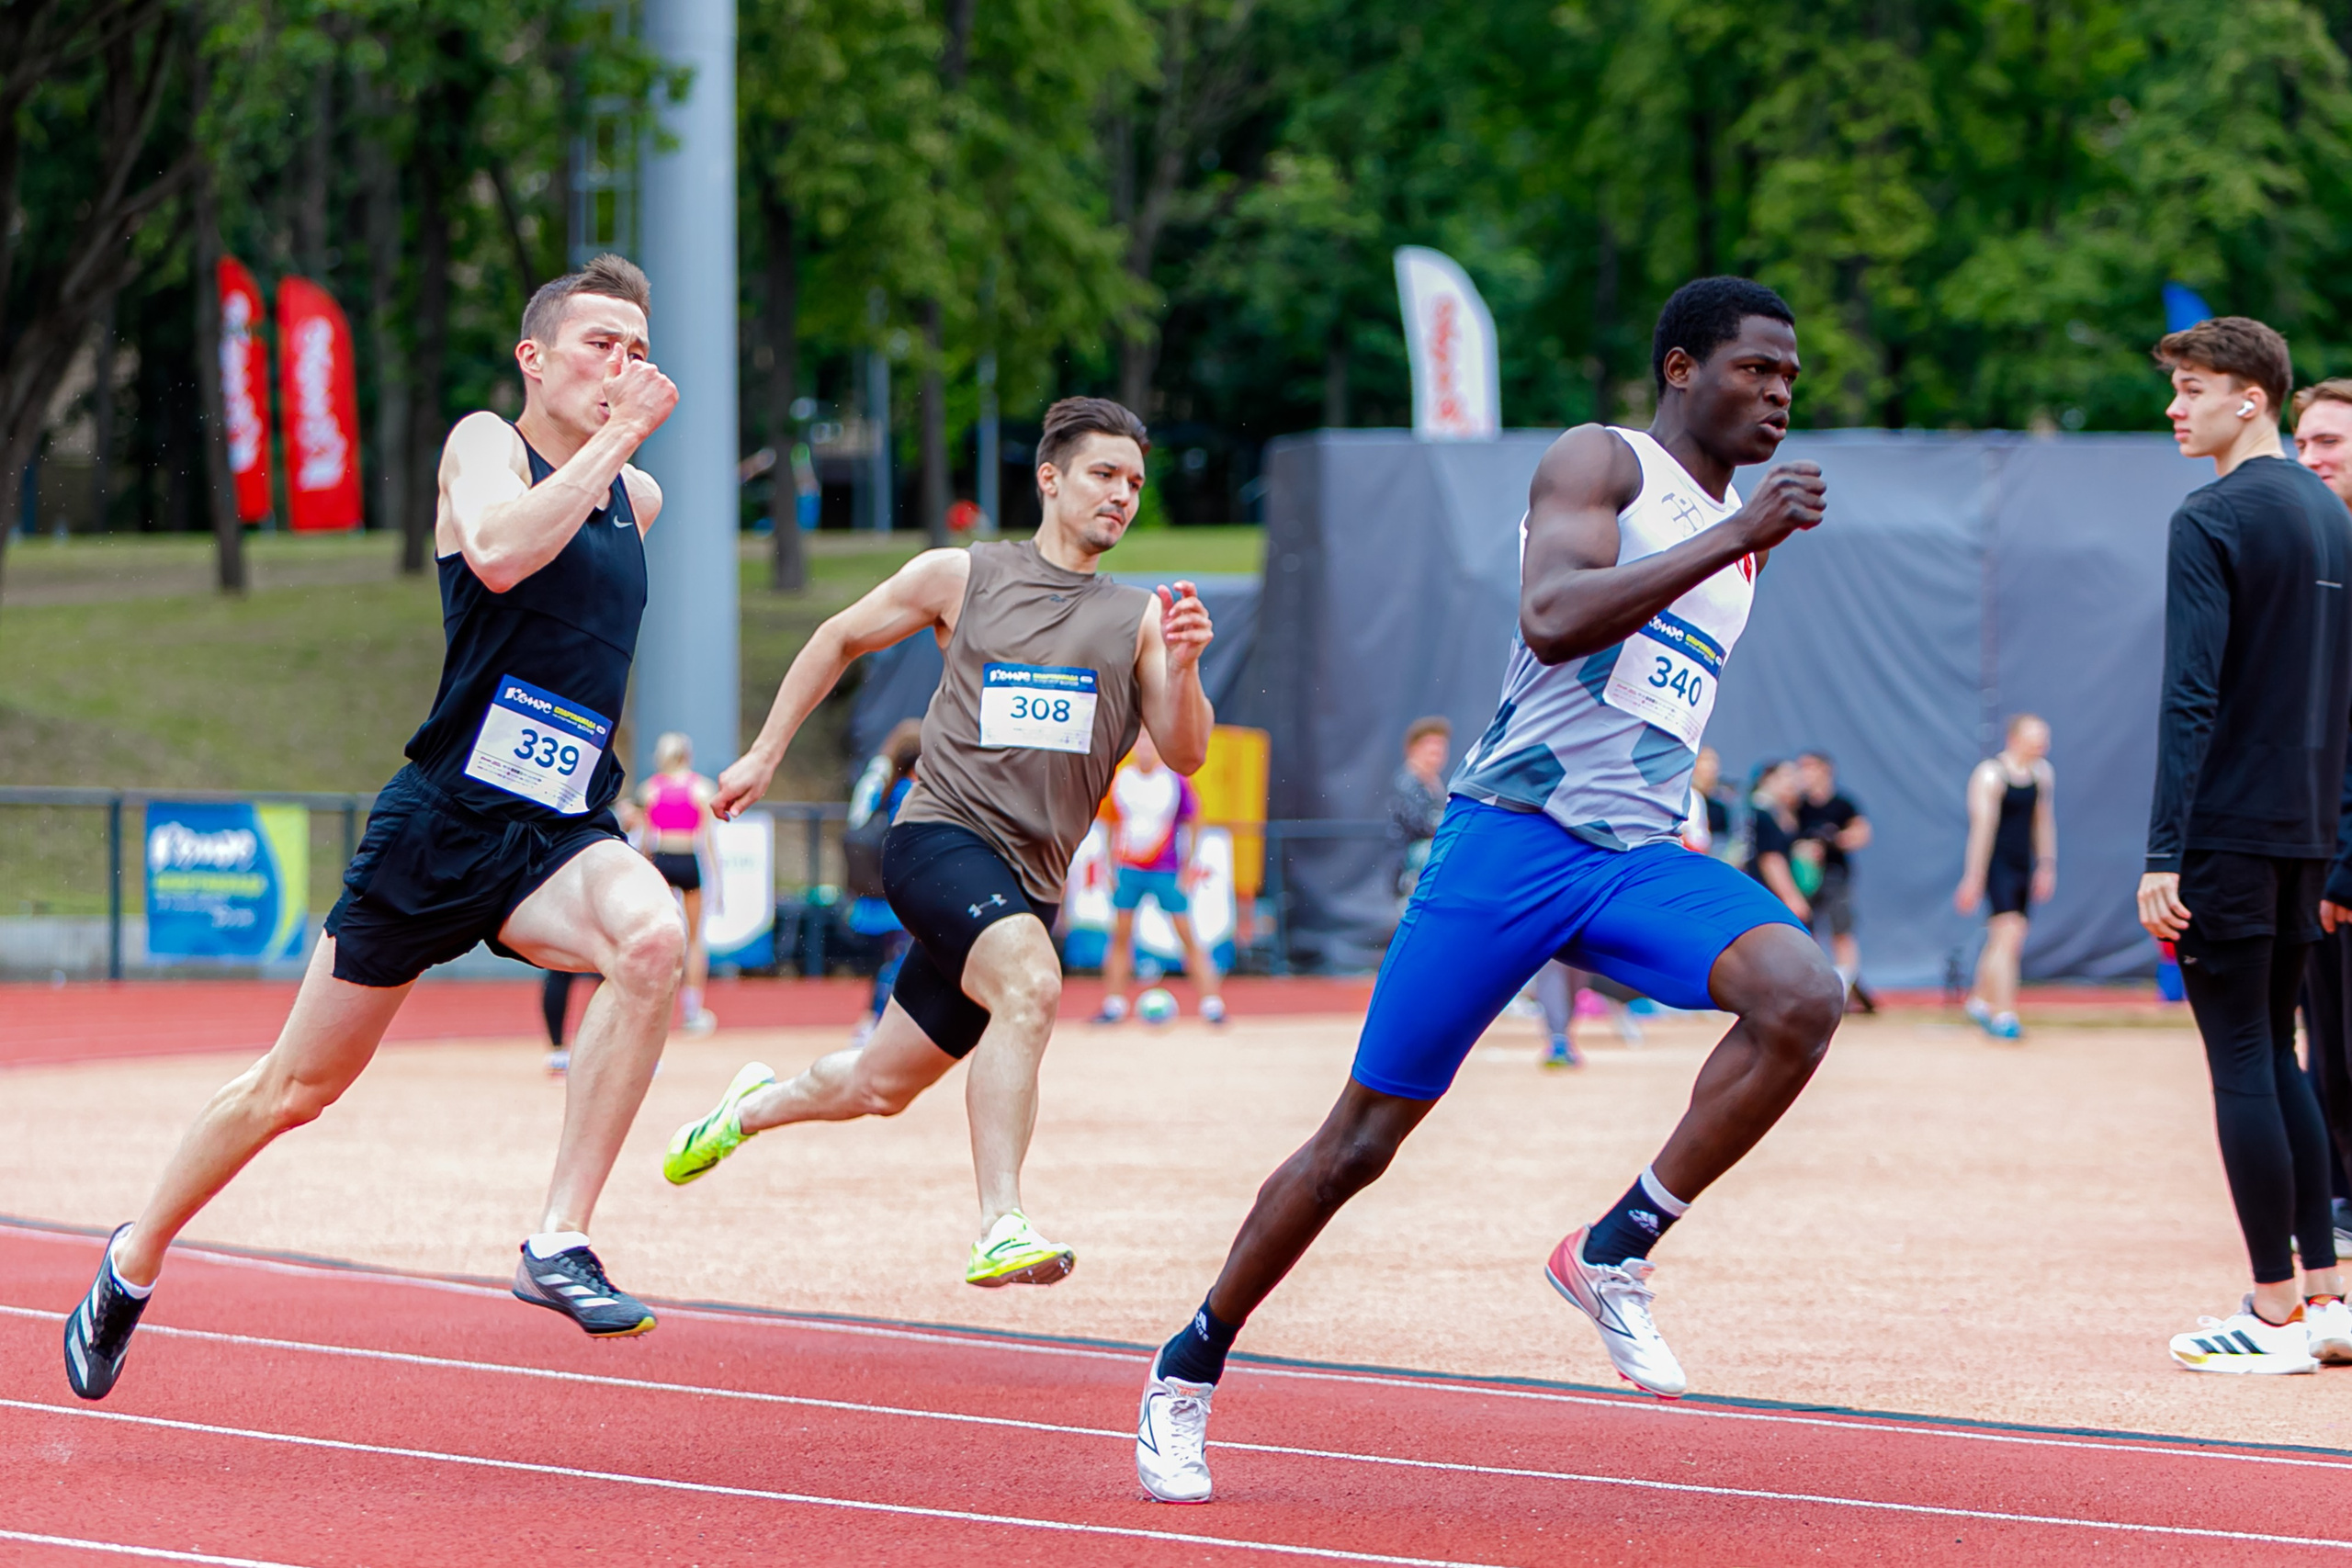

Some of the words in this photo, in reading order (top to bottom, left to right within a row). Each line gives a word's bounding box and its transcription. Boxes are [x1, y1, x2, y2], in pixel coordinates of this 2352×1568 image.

[1647, 655, 1702, 707] 340
[1010, 695, 1070, 723] 308
[514, 728, 580, 776] 339
